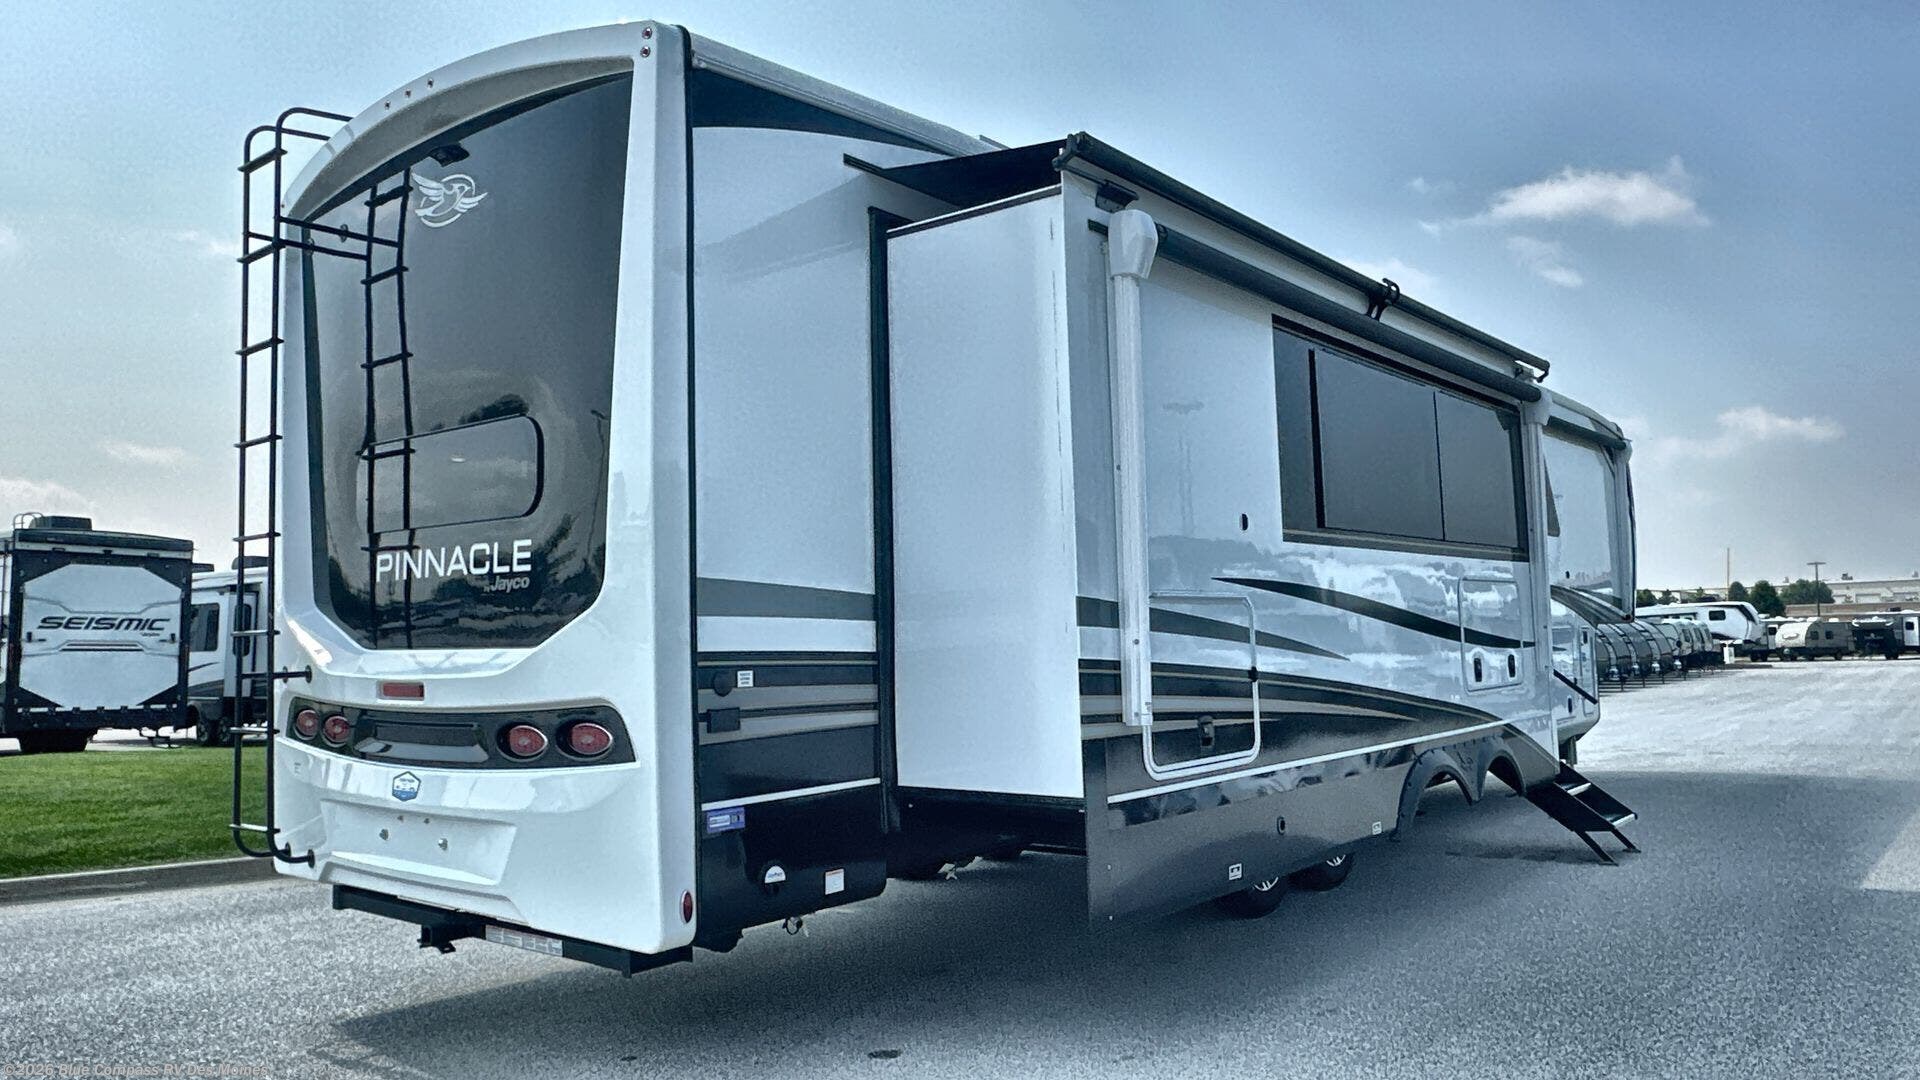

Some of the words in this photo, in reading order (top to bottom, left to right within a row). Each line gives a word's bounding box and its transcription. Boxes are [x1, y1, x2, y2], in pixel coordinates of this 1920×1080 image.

[376, 539, 532, 583] PINNACLE
[490, 575, 530, 593] Jayco
[36, 616, 171, 631] SEISMIC
